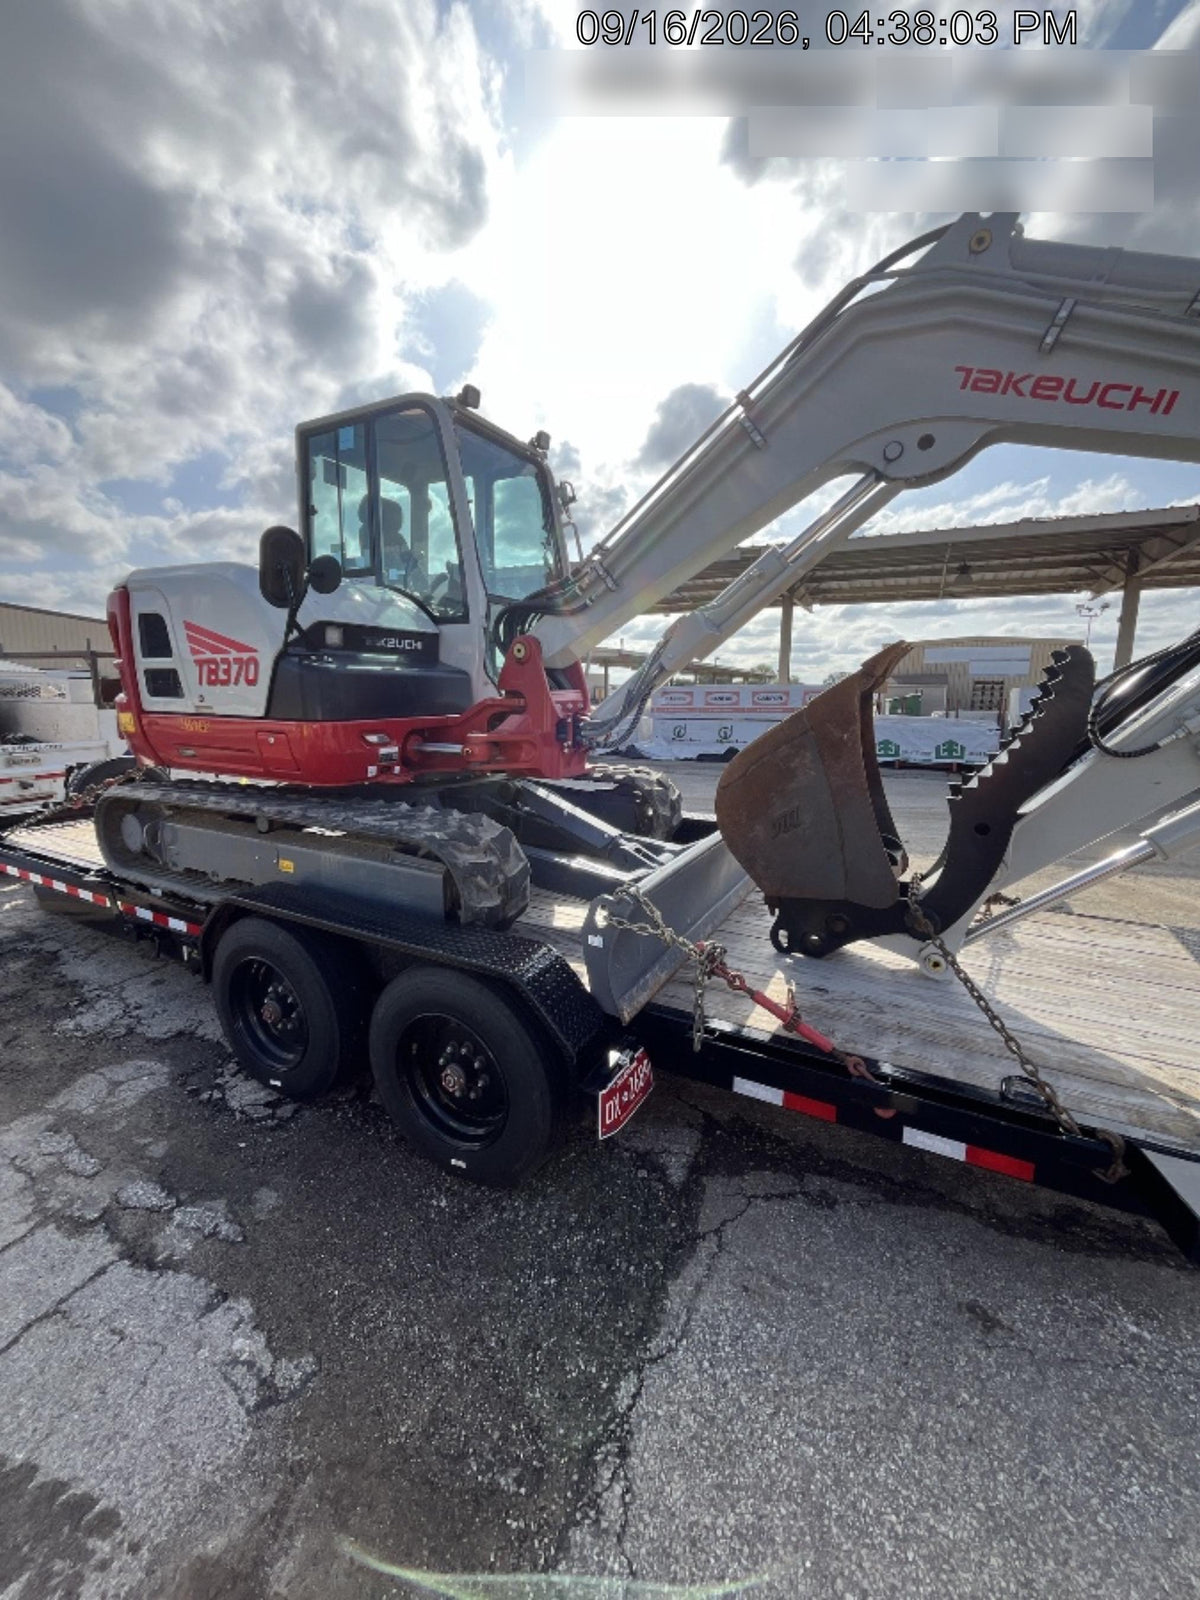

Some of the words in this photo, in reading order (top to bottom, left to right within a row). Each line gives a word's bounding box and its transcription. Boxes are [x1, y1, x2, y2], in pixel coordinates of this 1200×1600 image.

[954, 365, 1180, 415] TAKEUCHI
[362, 635, 423, 650] KEUCHI
[193, 655, 260, 687] TB370
